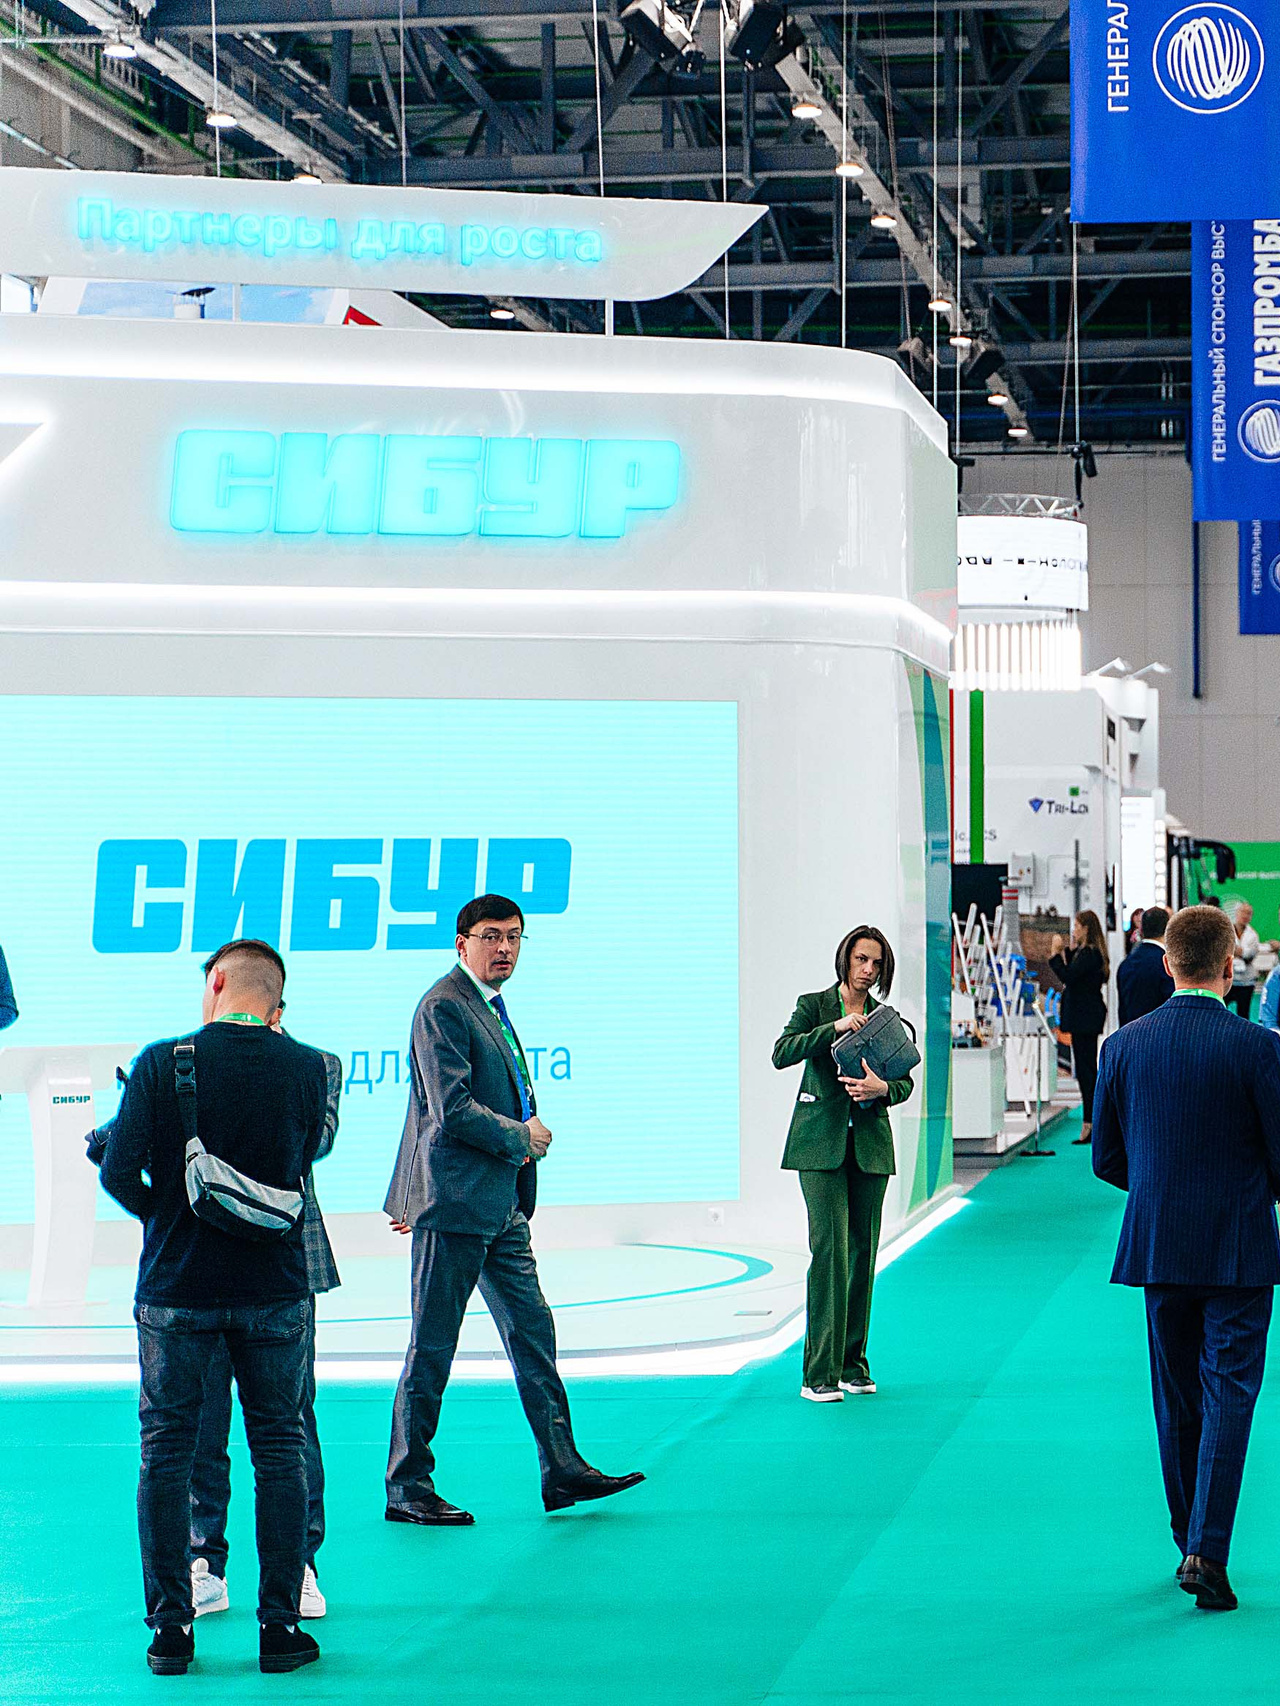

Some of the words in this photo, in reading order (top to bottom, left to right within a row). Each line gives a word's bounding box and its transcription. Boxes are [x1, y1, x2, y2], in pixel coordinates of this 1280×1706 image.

[77, 196, 338, 258] Партнеры
[350, 218, 447, 261] для
[460, 223, 603, 267] роста
[1210, 262, 1226, 345] СПОНСОР
[1208, 347, 1227, 462] ГЕНЕРАЛЬНЫЙ
[170, 429, 681, 538] СИБУР
[92, 837, 572, 954] СИБУР
[52, 1094, 92, 1105] СИБУР
[345, 1049, 412, 1095] дл
